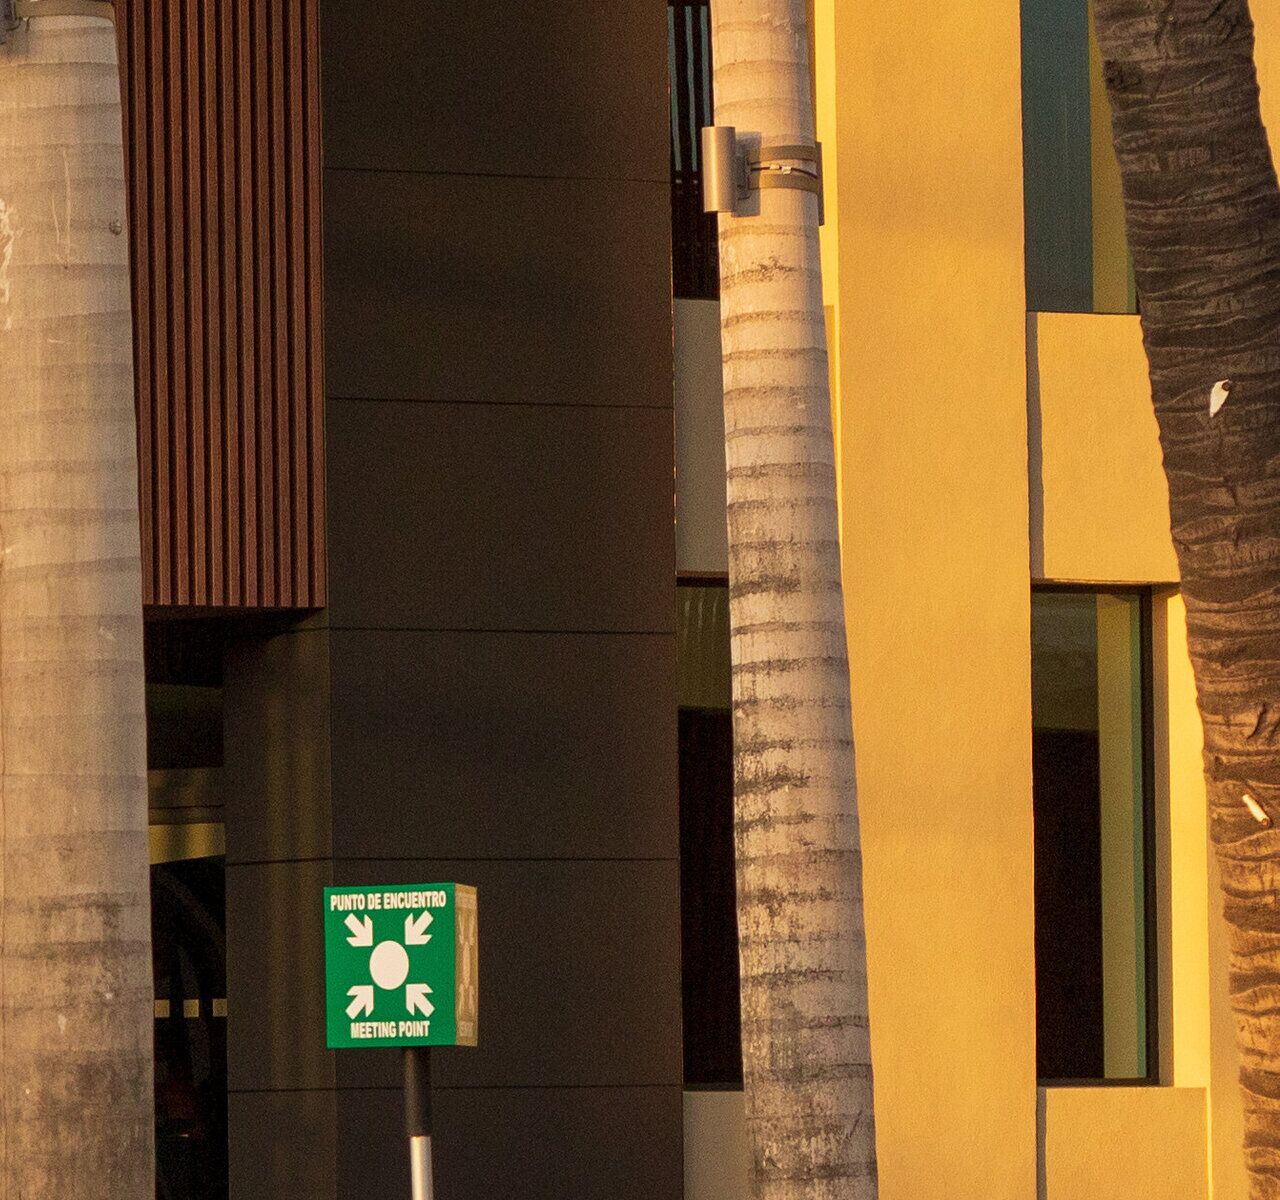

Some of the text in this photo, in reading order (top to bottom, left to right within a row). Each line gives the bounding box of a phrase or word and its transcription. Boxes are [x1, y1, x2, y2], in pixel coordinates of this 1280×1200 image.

[330, 890, 447, 911] PUNTO DE ENCUENTRO
[350, 1020, 431, 1039] MEETING POINT
